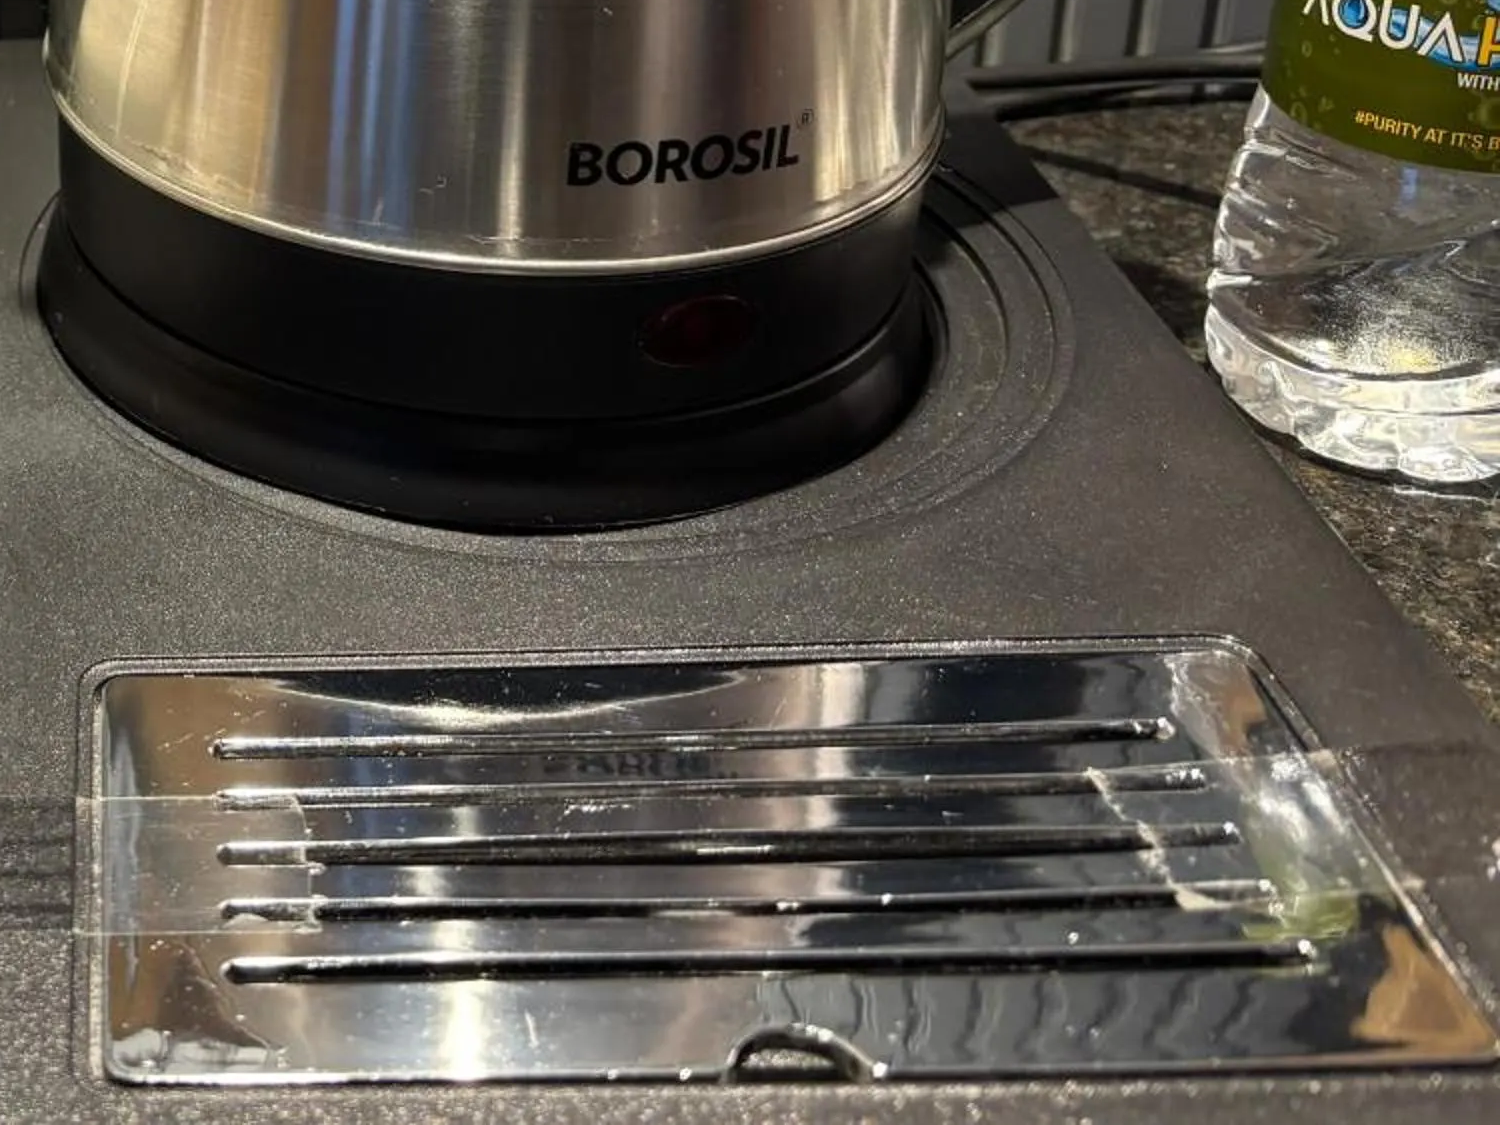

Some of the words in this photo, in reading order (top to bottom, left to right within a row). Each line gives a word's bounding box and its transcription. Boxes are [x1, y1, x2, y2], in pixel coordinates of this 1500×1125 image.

[1355, 110, 1422, 140] #PURITY
[1423, 126, 1449, 145] AT
[566, 124, 799, 186] BOROSIL
